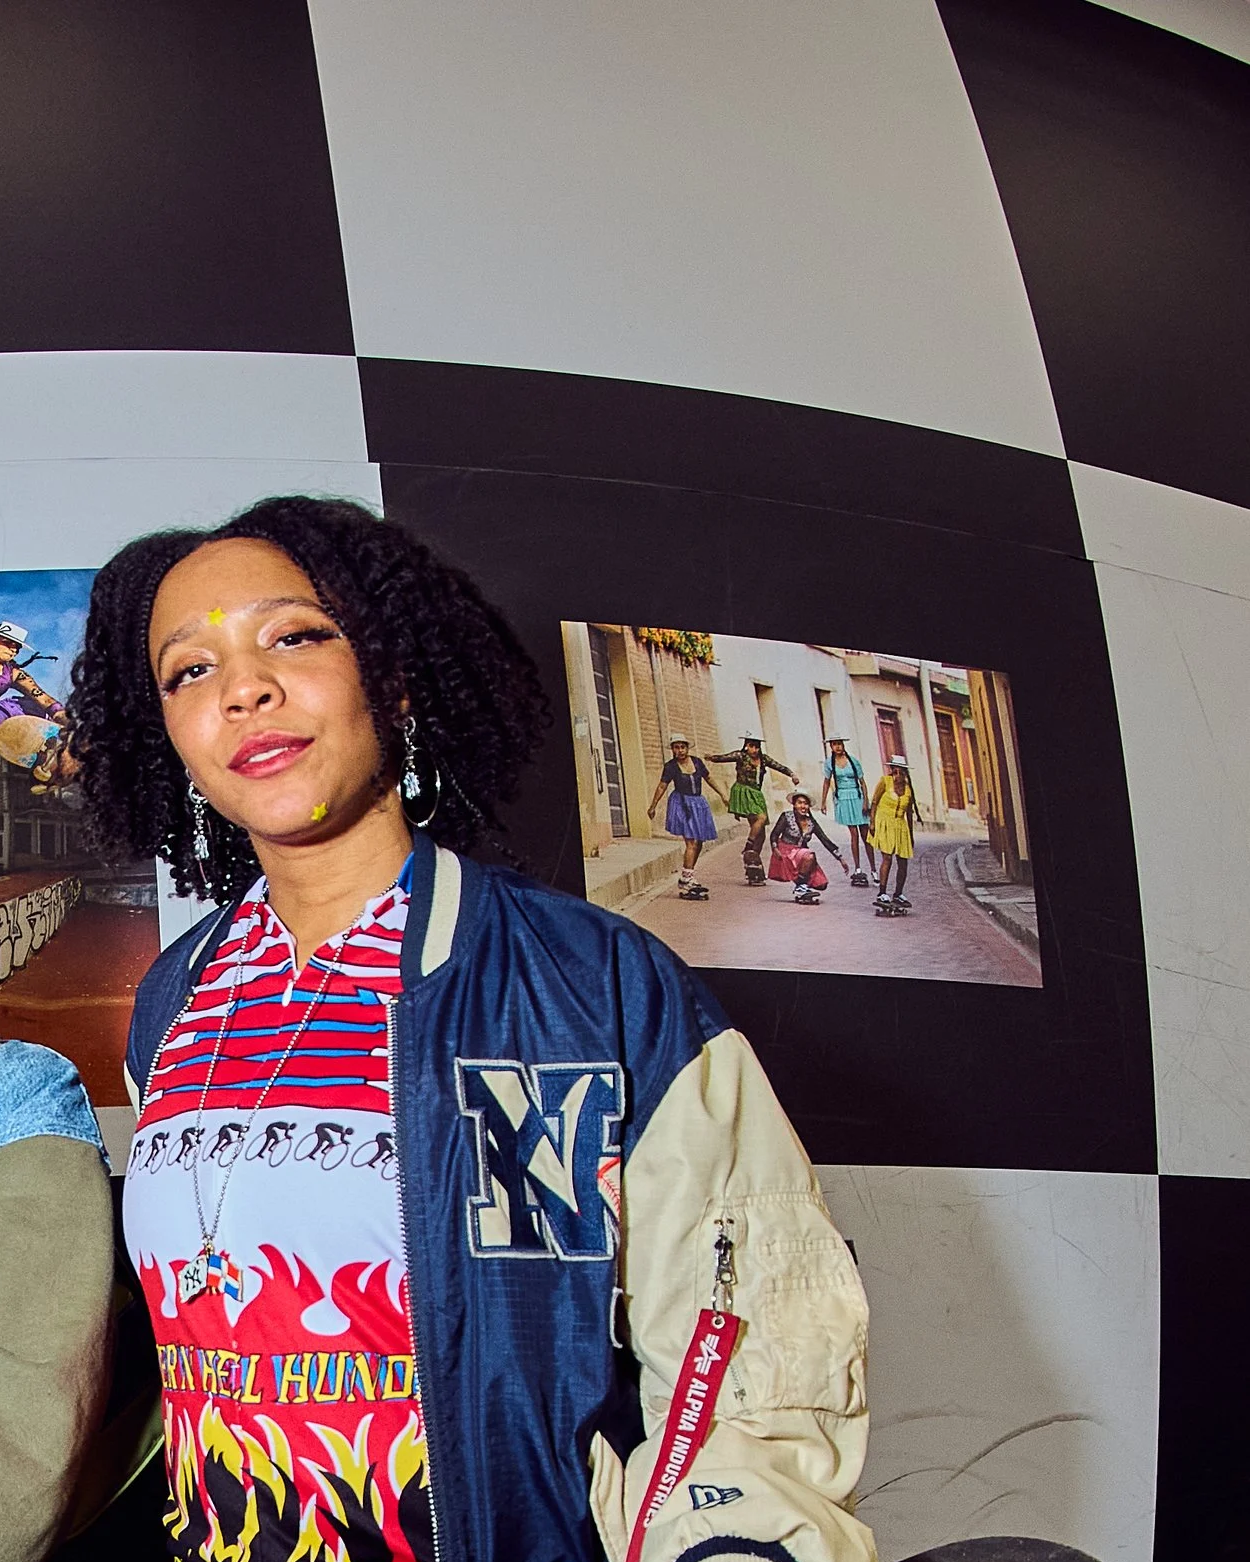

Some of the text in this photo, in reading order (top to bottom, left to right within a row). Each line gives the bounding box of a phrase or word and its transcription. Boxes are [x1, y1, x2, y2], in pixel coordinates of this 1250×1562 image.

[269, 1350, 422, 1407] HUND
[642, 1377, 709, 1529] ALPHA INDUSTRIES
